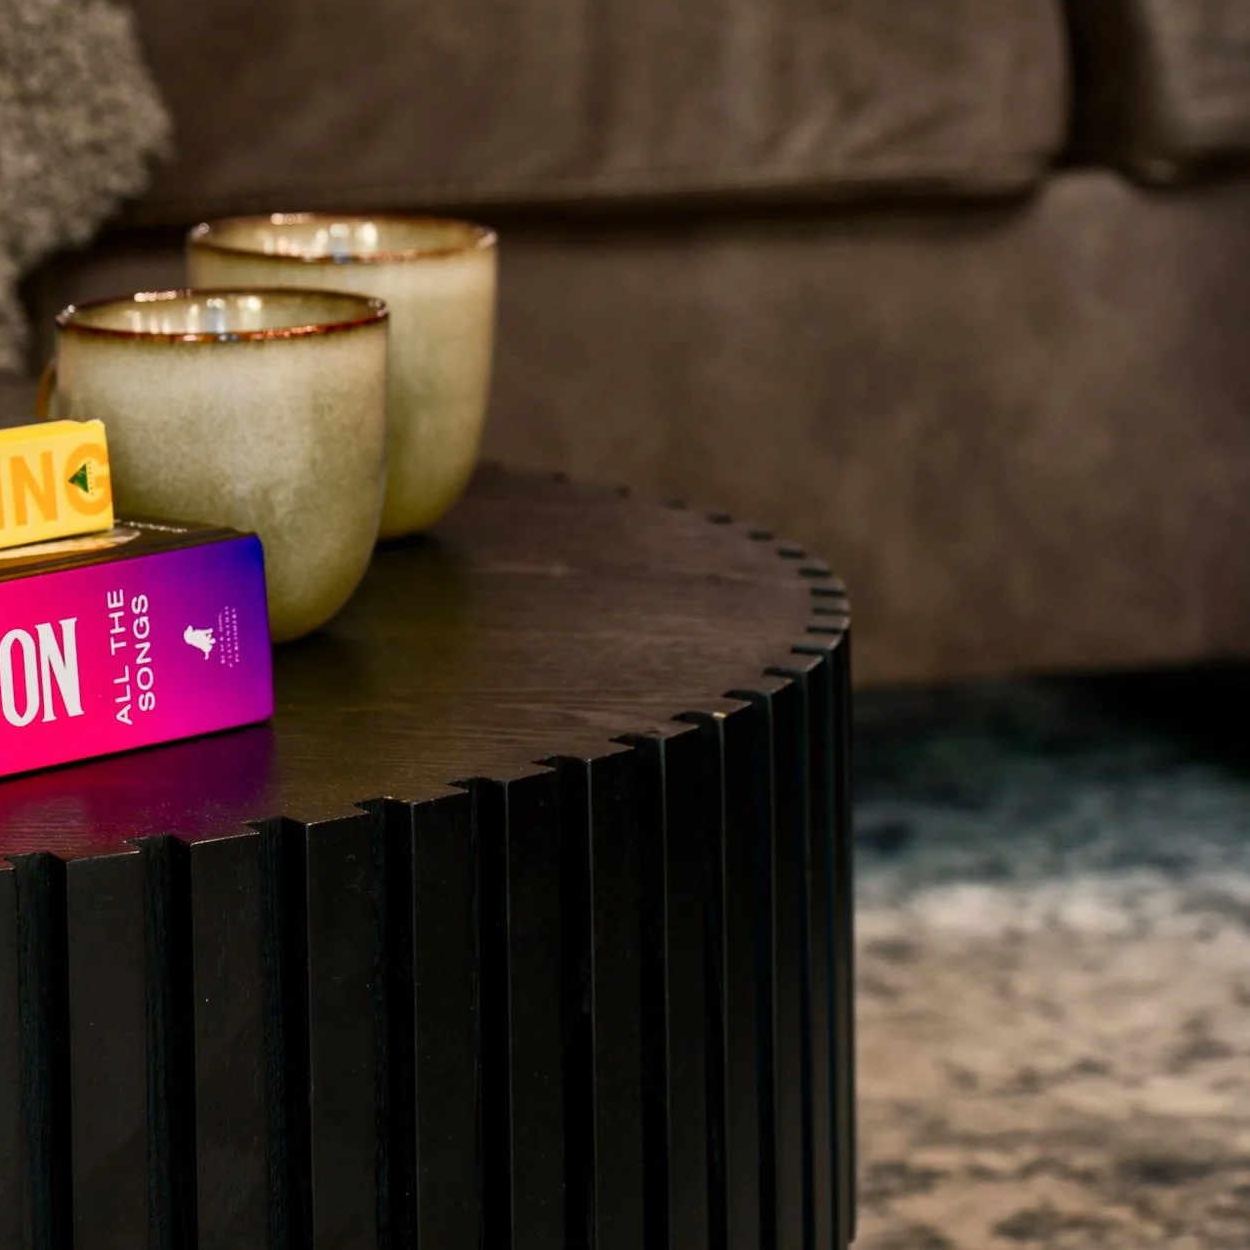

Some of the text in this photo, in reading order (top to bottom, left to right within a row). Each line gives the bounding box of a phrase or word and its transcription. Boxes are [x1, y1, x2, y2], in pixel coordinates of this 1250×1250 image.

[106, 588, 133, 726] ALL THE
[131, 593, 156, 712] SONGS
